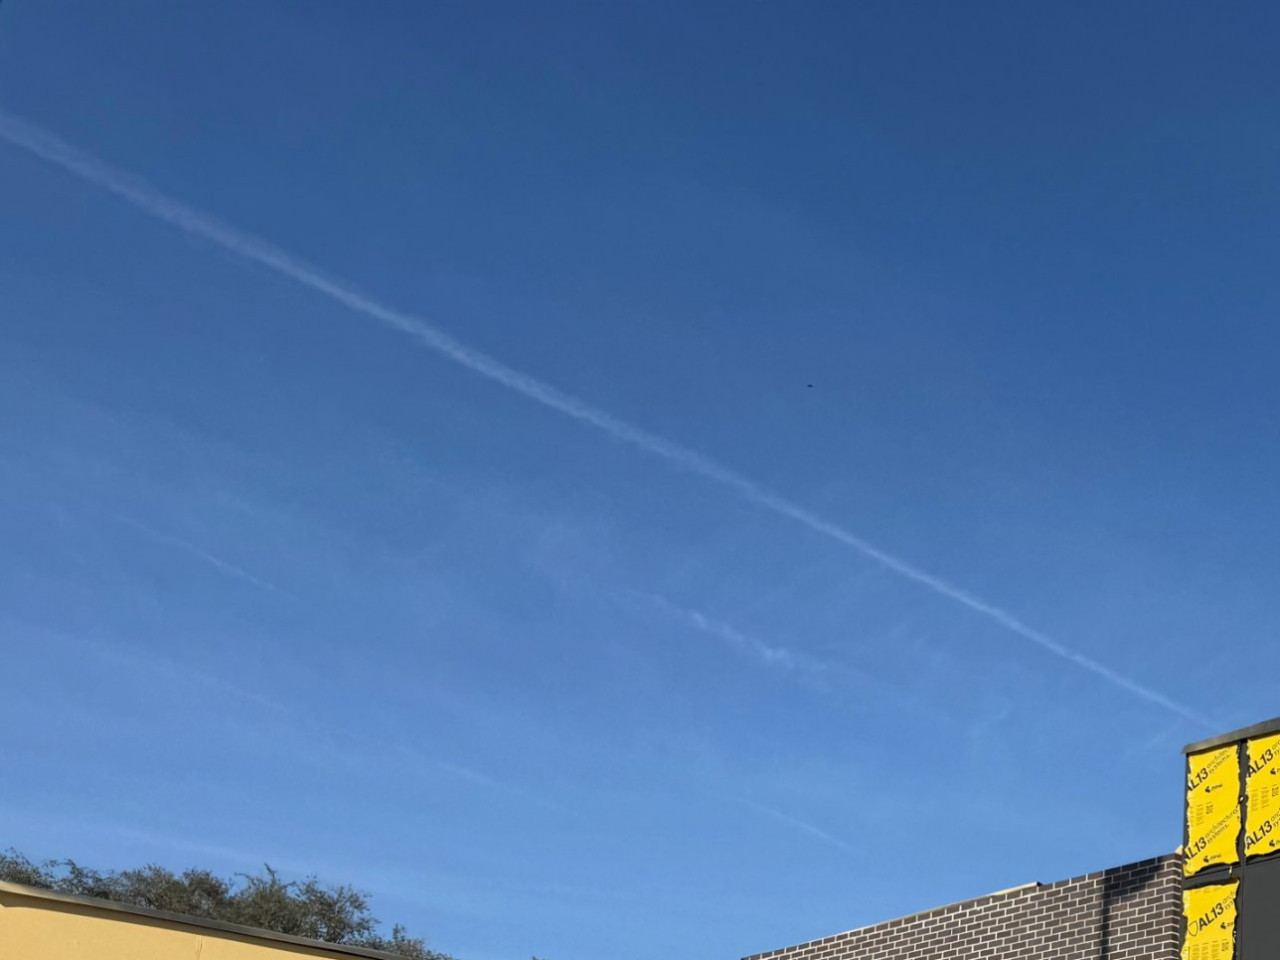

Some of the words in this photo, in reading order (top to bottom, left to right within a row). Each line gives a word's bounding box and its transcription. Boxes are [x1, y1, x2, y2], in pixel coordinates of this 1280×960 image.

[1248, 748, 1274, 778] AL13
[1246, 820, 1272, 850] AL13
[1198, 902, 1224, 931] AL13
